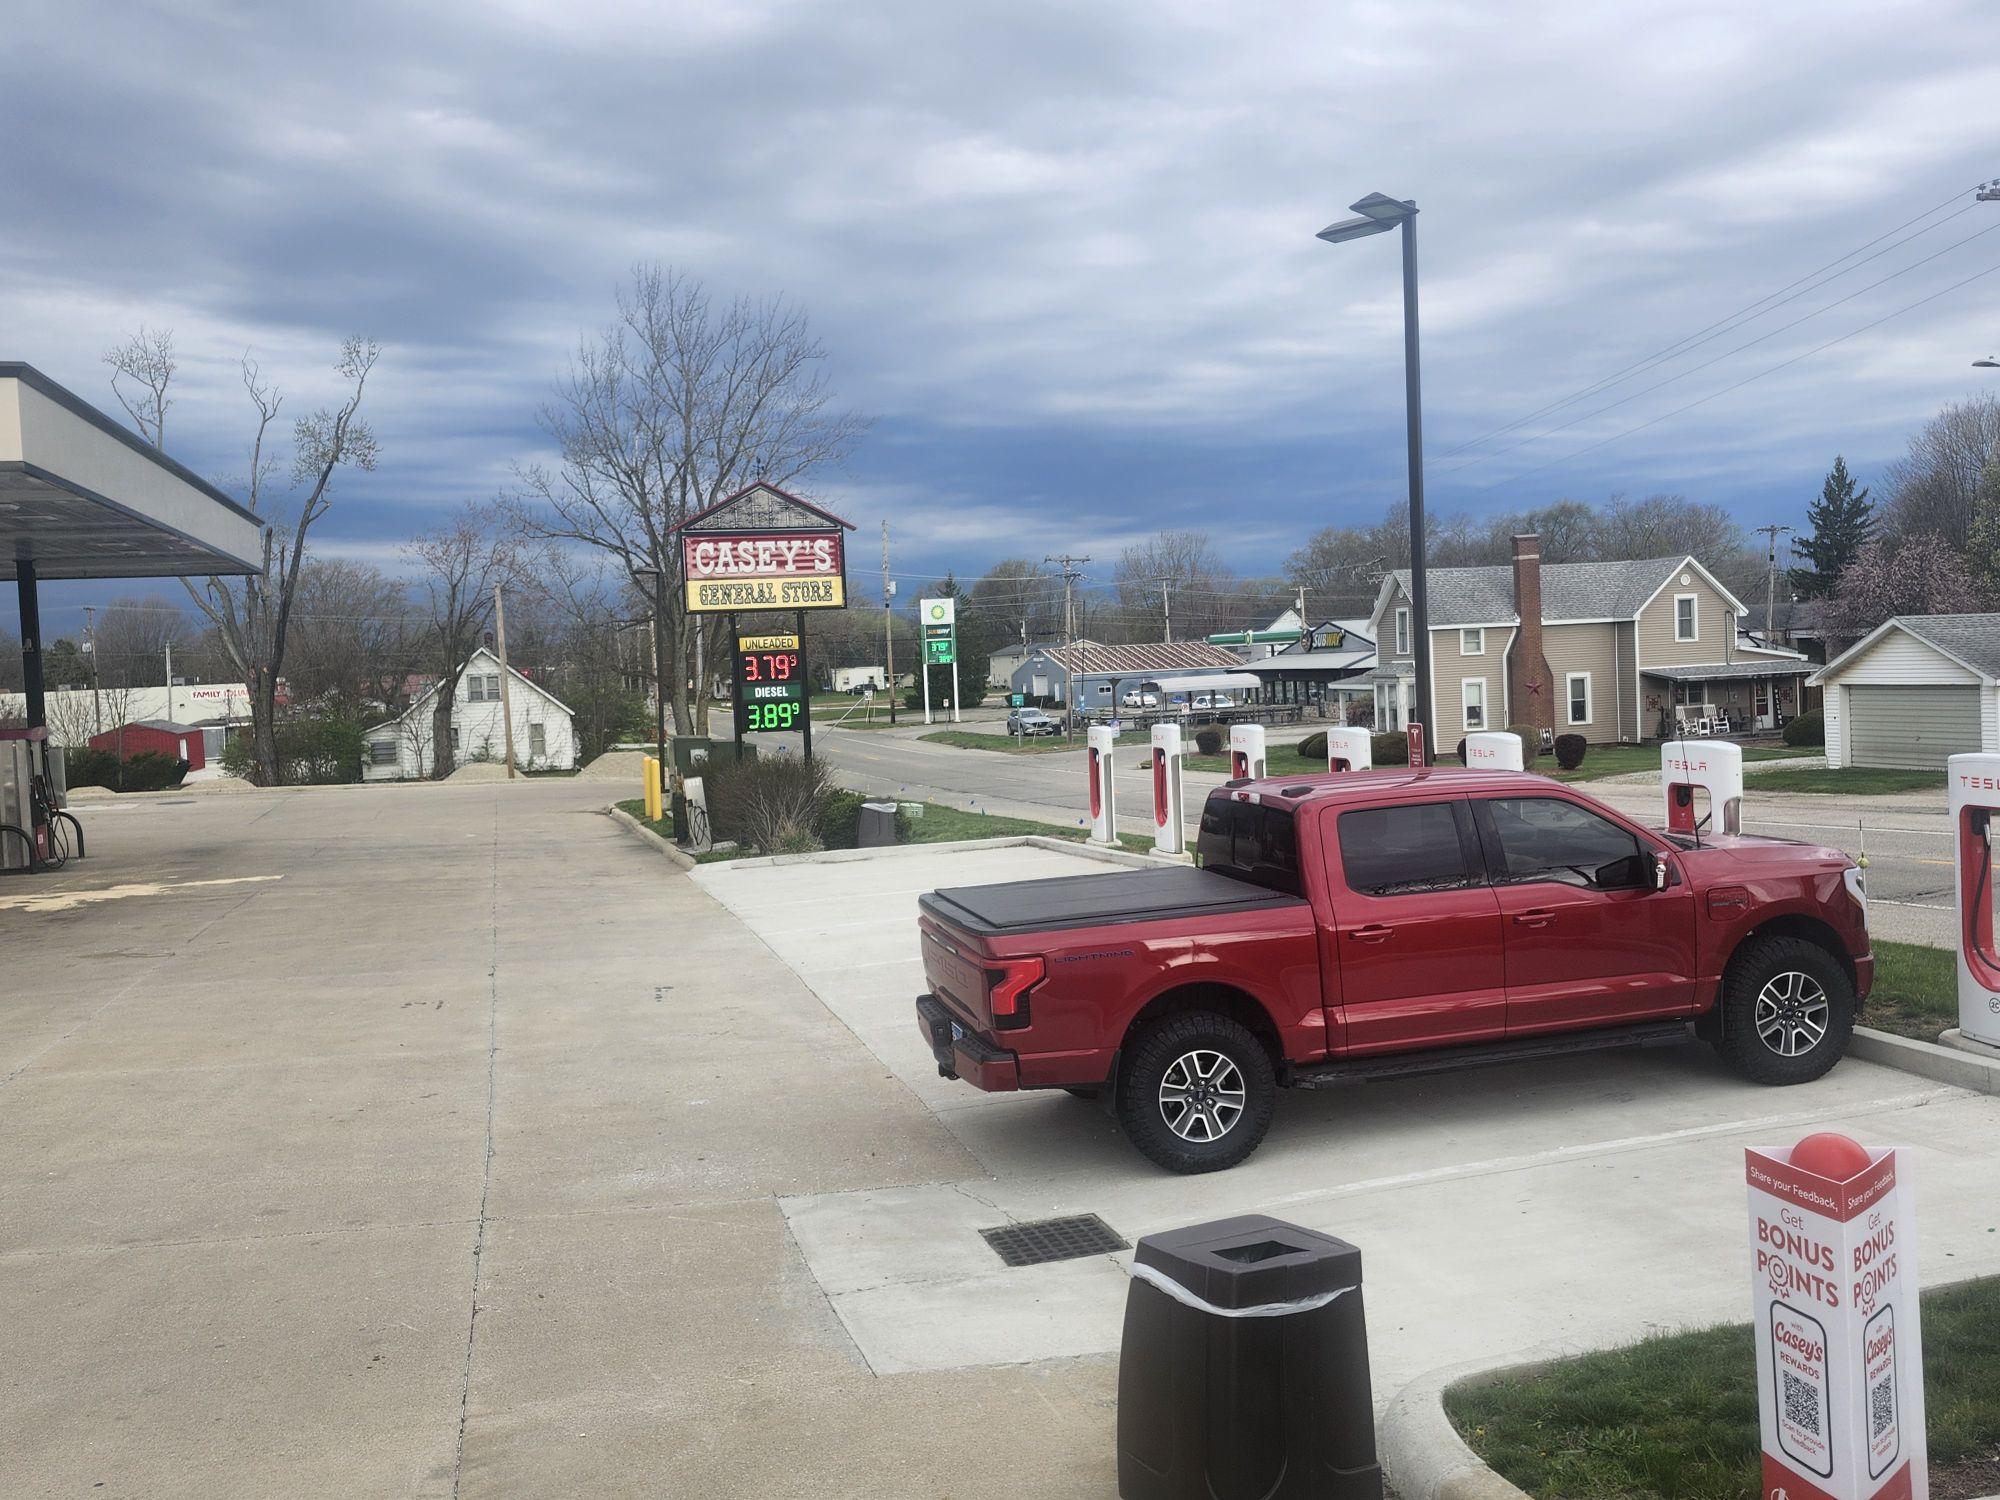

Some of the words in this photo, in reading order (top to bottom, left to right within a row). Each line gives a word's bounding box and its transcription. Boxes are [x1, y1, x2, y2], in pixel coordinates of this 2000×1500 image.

[696, 539, 832, 575] CASEY'S
[699, 582, 777, 605] GENERAL
[781, 580, 833, 603] STORE
[745, 638, 794, 650] UNLEADED
[1313, 630, 1345, 648] SUBWAY
[192, 691, 220, 699] FAMILY
[754, 686, 789, 698] DIESEL
[1329, 740, 1349, 749] TESLA
[1469, 747, 1496, 758] TESLA
[1667, 759, 1707, 772] TESLA
[1960, 775, 2000, 790] TESL
[1750, 1166, 1772, 1185] Share
[1772, 1178, 1792, 1192] your
[1848, 1194, 1864, 1210] Share
[1863, 1187, 1875, 1204] your
[1780, 1207, 1804, 1231] Get
[1868, 1212, 1881, 1230] Get
[1757, 1216, 1835, 1272] BONUS
[1853, 1220, 1895, 1273] BONUS
[1757, 1248, 1839, 1308] POINTS
[1853, 1252, 1897, 1309] POINTS
[1774, 1321, 1823, 1362] Casey's
[1866, 1325, 1893, 1365] Casey's
[1779, 1351, 1820, 1380] REWARDS
[1869, 1355, 1891, 1380] REWARDS
